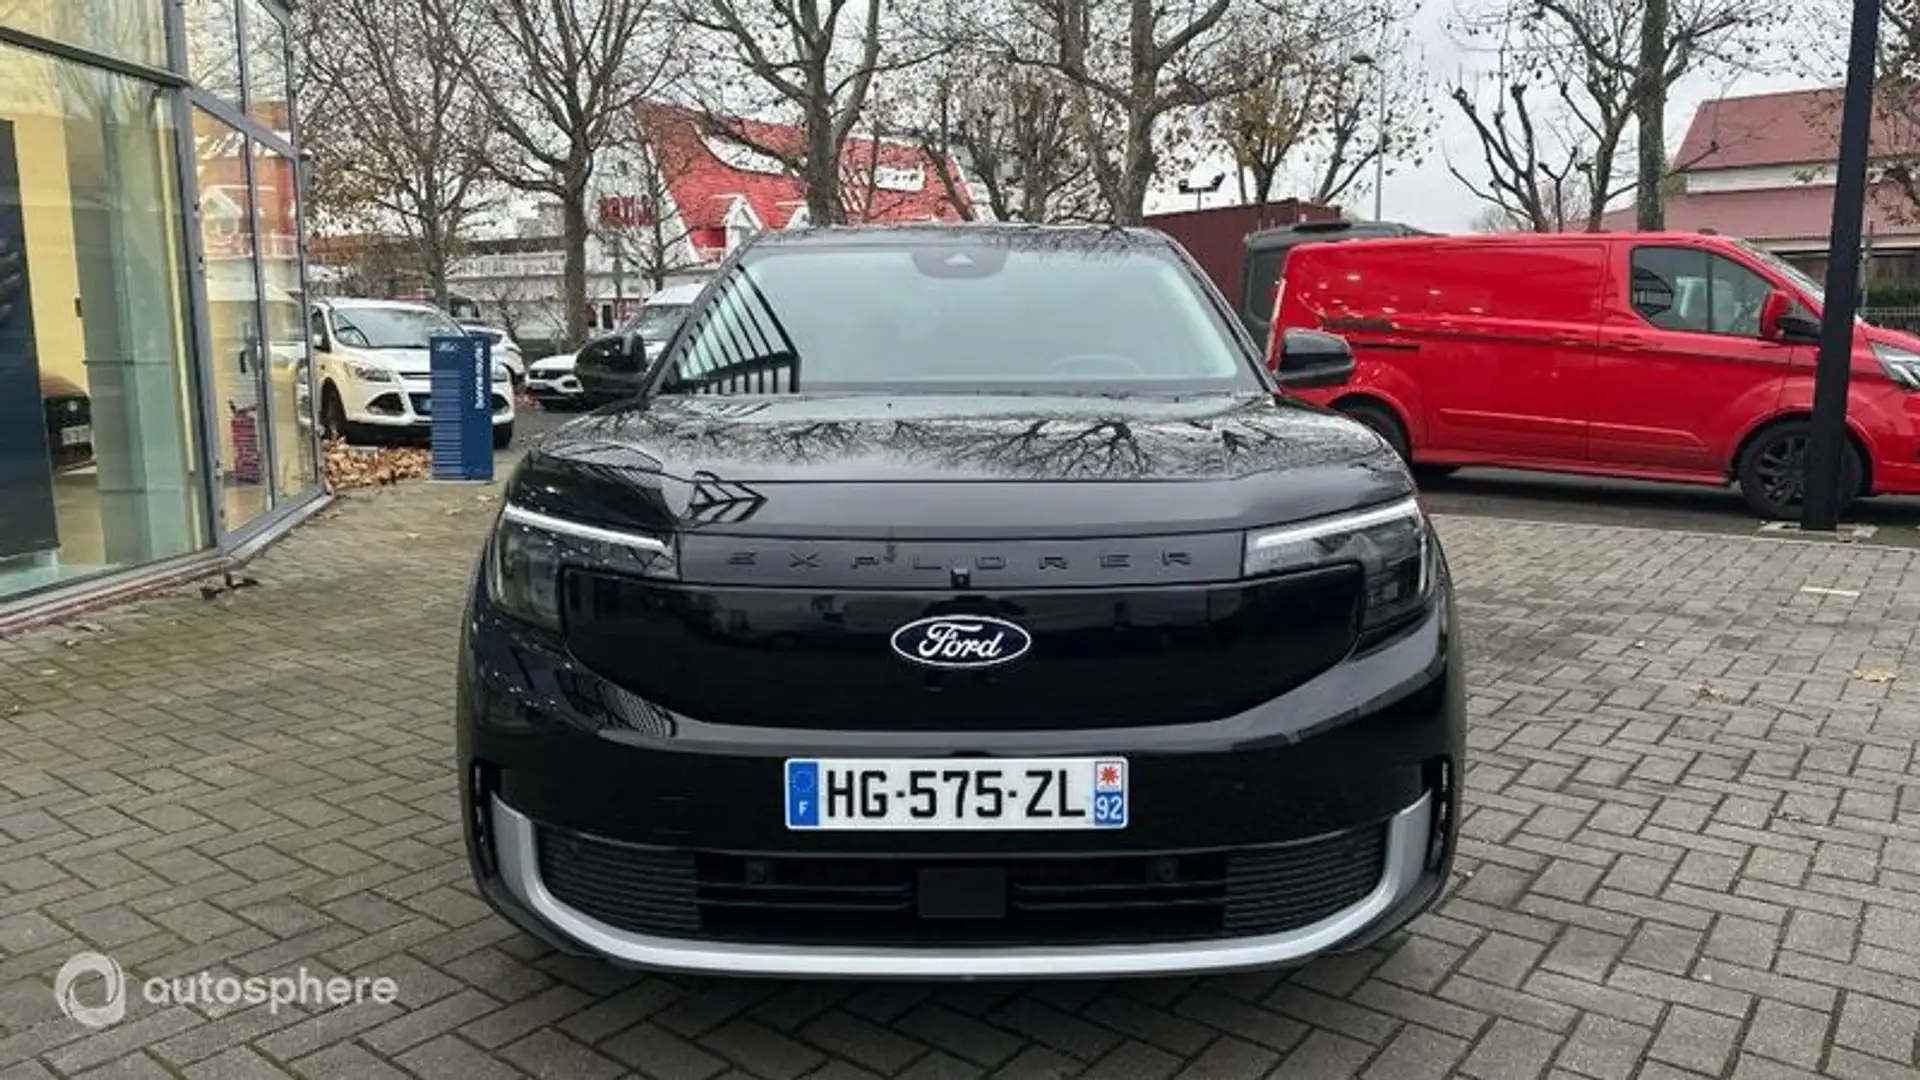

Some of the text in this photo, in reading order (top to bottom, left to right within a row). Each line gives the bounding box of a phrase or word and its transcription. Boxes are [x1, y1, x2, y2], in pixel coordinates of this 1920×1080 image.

[727, 550, 1193, 571] EXPLORER
[918, 622, 1004, 658] Ford
[799, 769, 1123, 820] F HG-575-ZL 92
